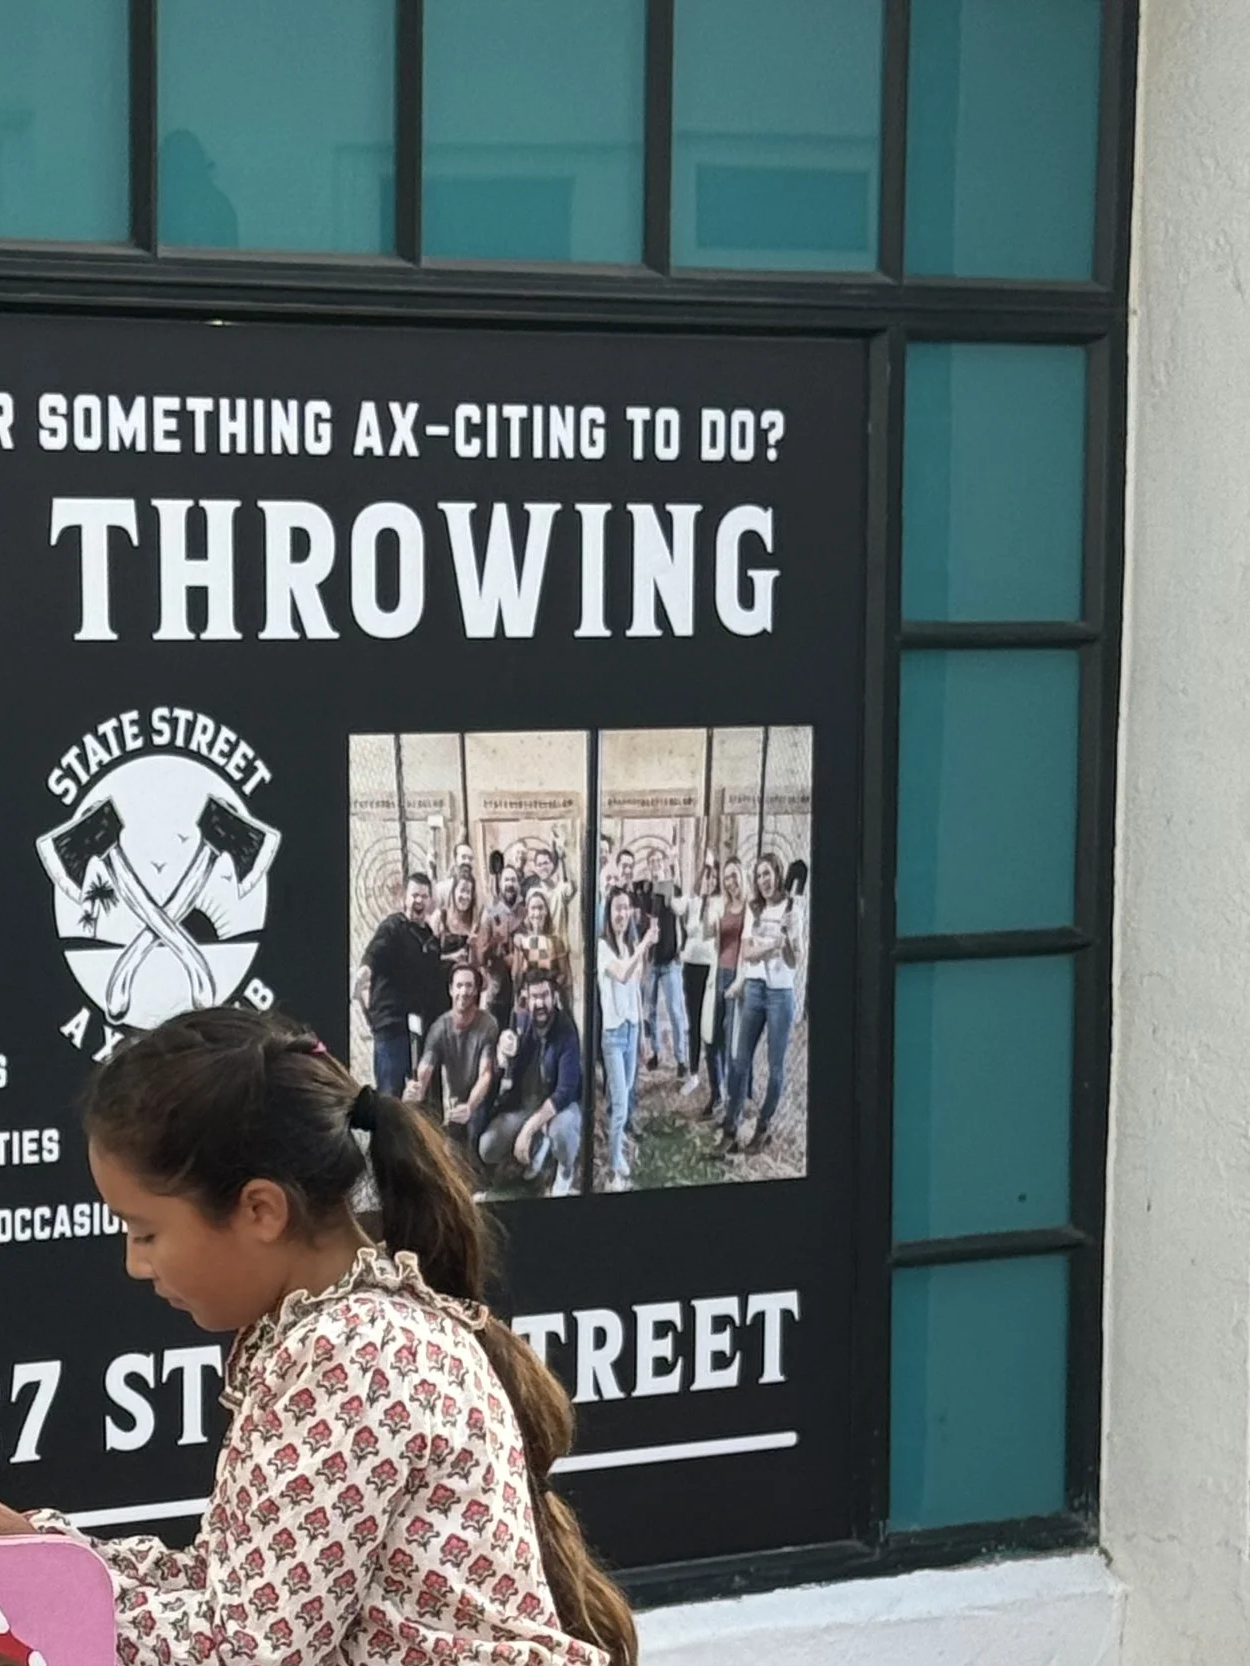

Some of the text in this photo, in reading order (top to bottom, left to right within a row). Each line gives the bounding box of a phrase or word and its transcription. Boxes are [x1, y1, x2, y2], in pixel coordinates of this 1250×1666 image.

[38, 392, 332, 455] SOMETHING
[353, 400, 606, 460] AX-CITING
[625, 406, 680, 461] TO
[700, 408, 785, 462] DO?
[50, 497, 781, 641] THROWING
[46, 706, 272, 805] STATE STREET
[105, 1344, 223, 1453] ST
[510, 1290, 799, 1405] TREET
